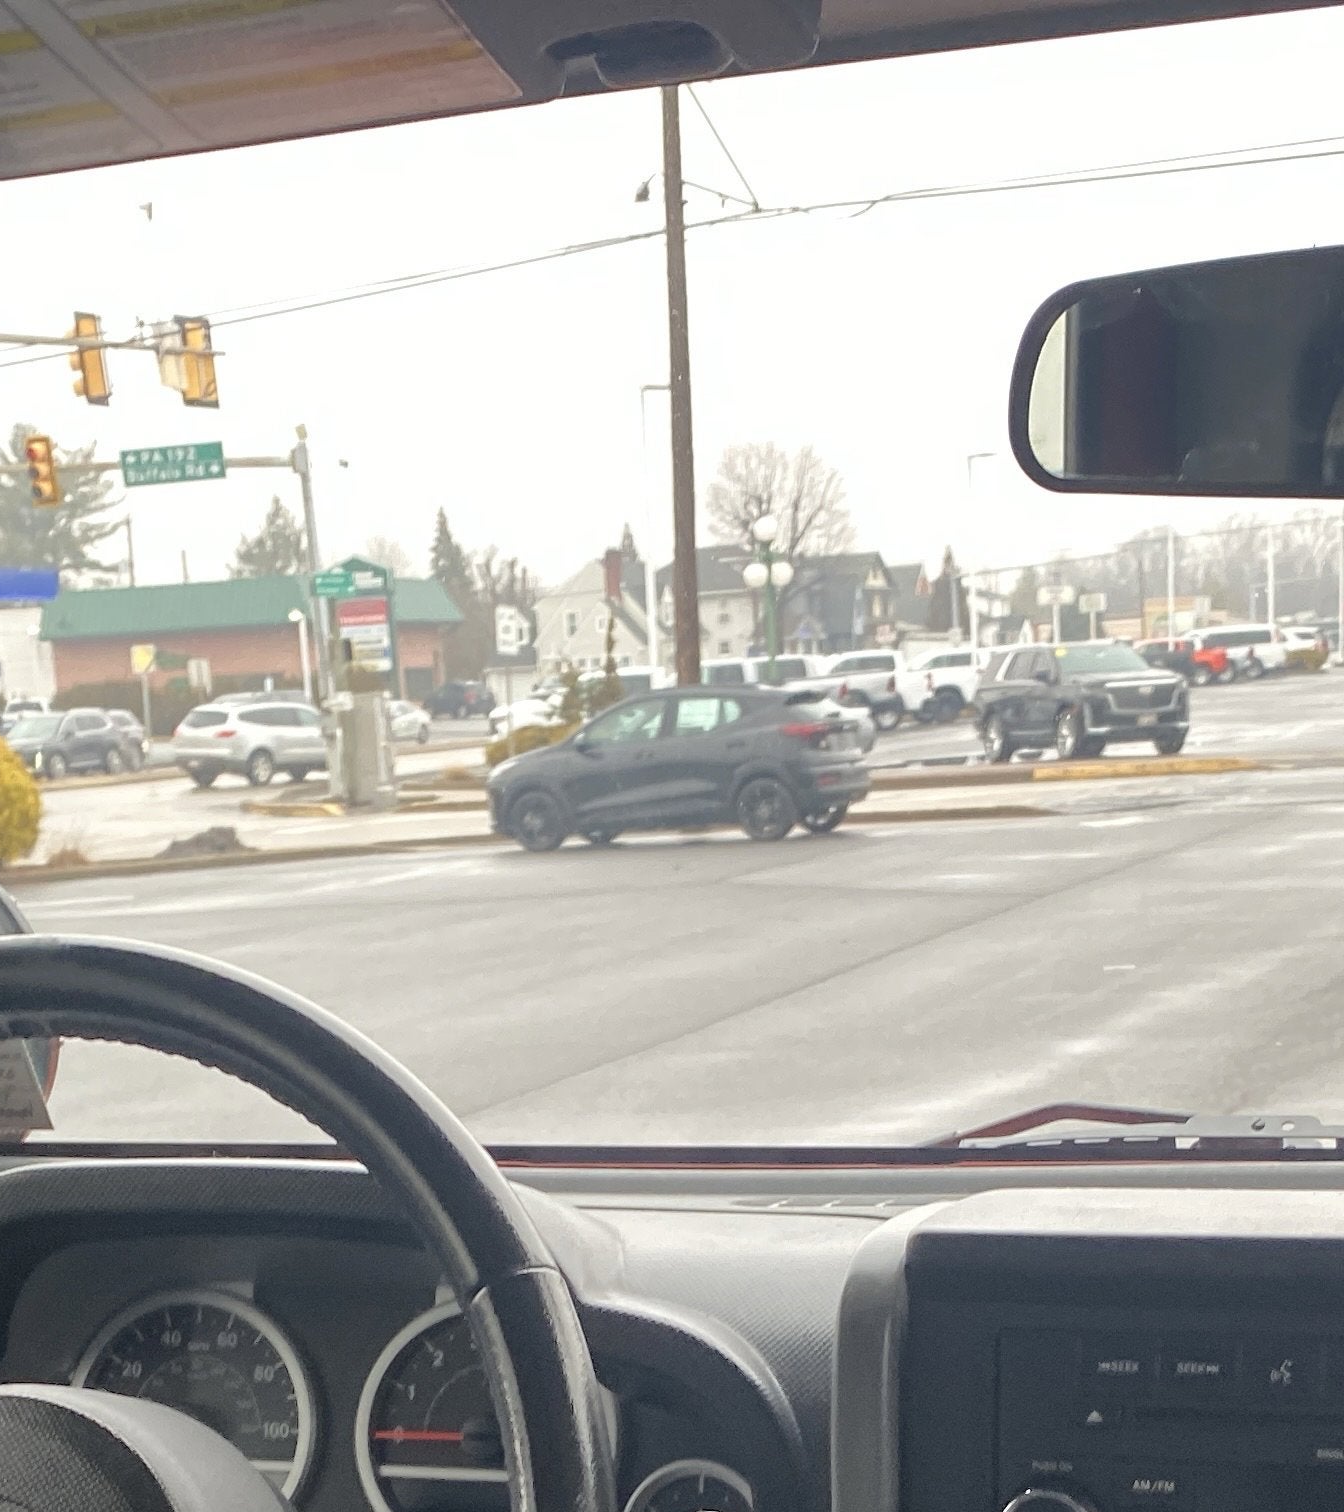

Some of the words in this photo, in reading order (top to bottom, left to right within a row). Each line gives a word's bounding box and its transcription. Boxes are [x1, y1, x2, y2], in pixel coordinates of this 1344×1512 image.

[140, 449, 164, 464] PA
[167, 446, 195, 462] 192
[126, 467, 182, 483] Buffalo
[185, 463, 205, 477] Rd
[432, 1349, 444, 1367] 2
[123, 1360, 142, 1378] 20
[262, 1422, 290, 1438] 100
[1132, 1479, 1176, 1493] AM/FM
